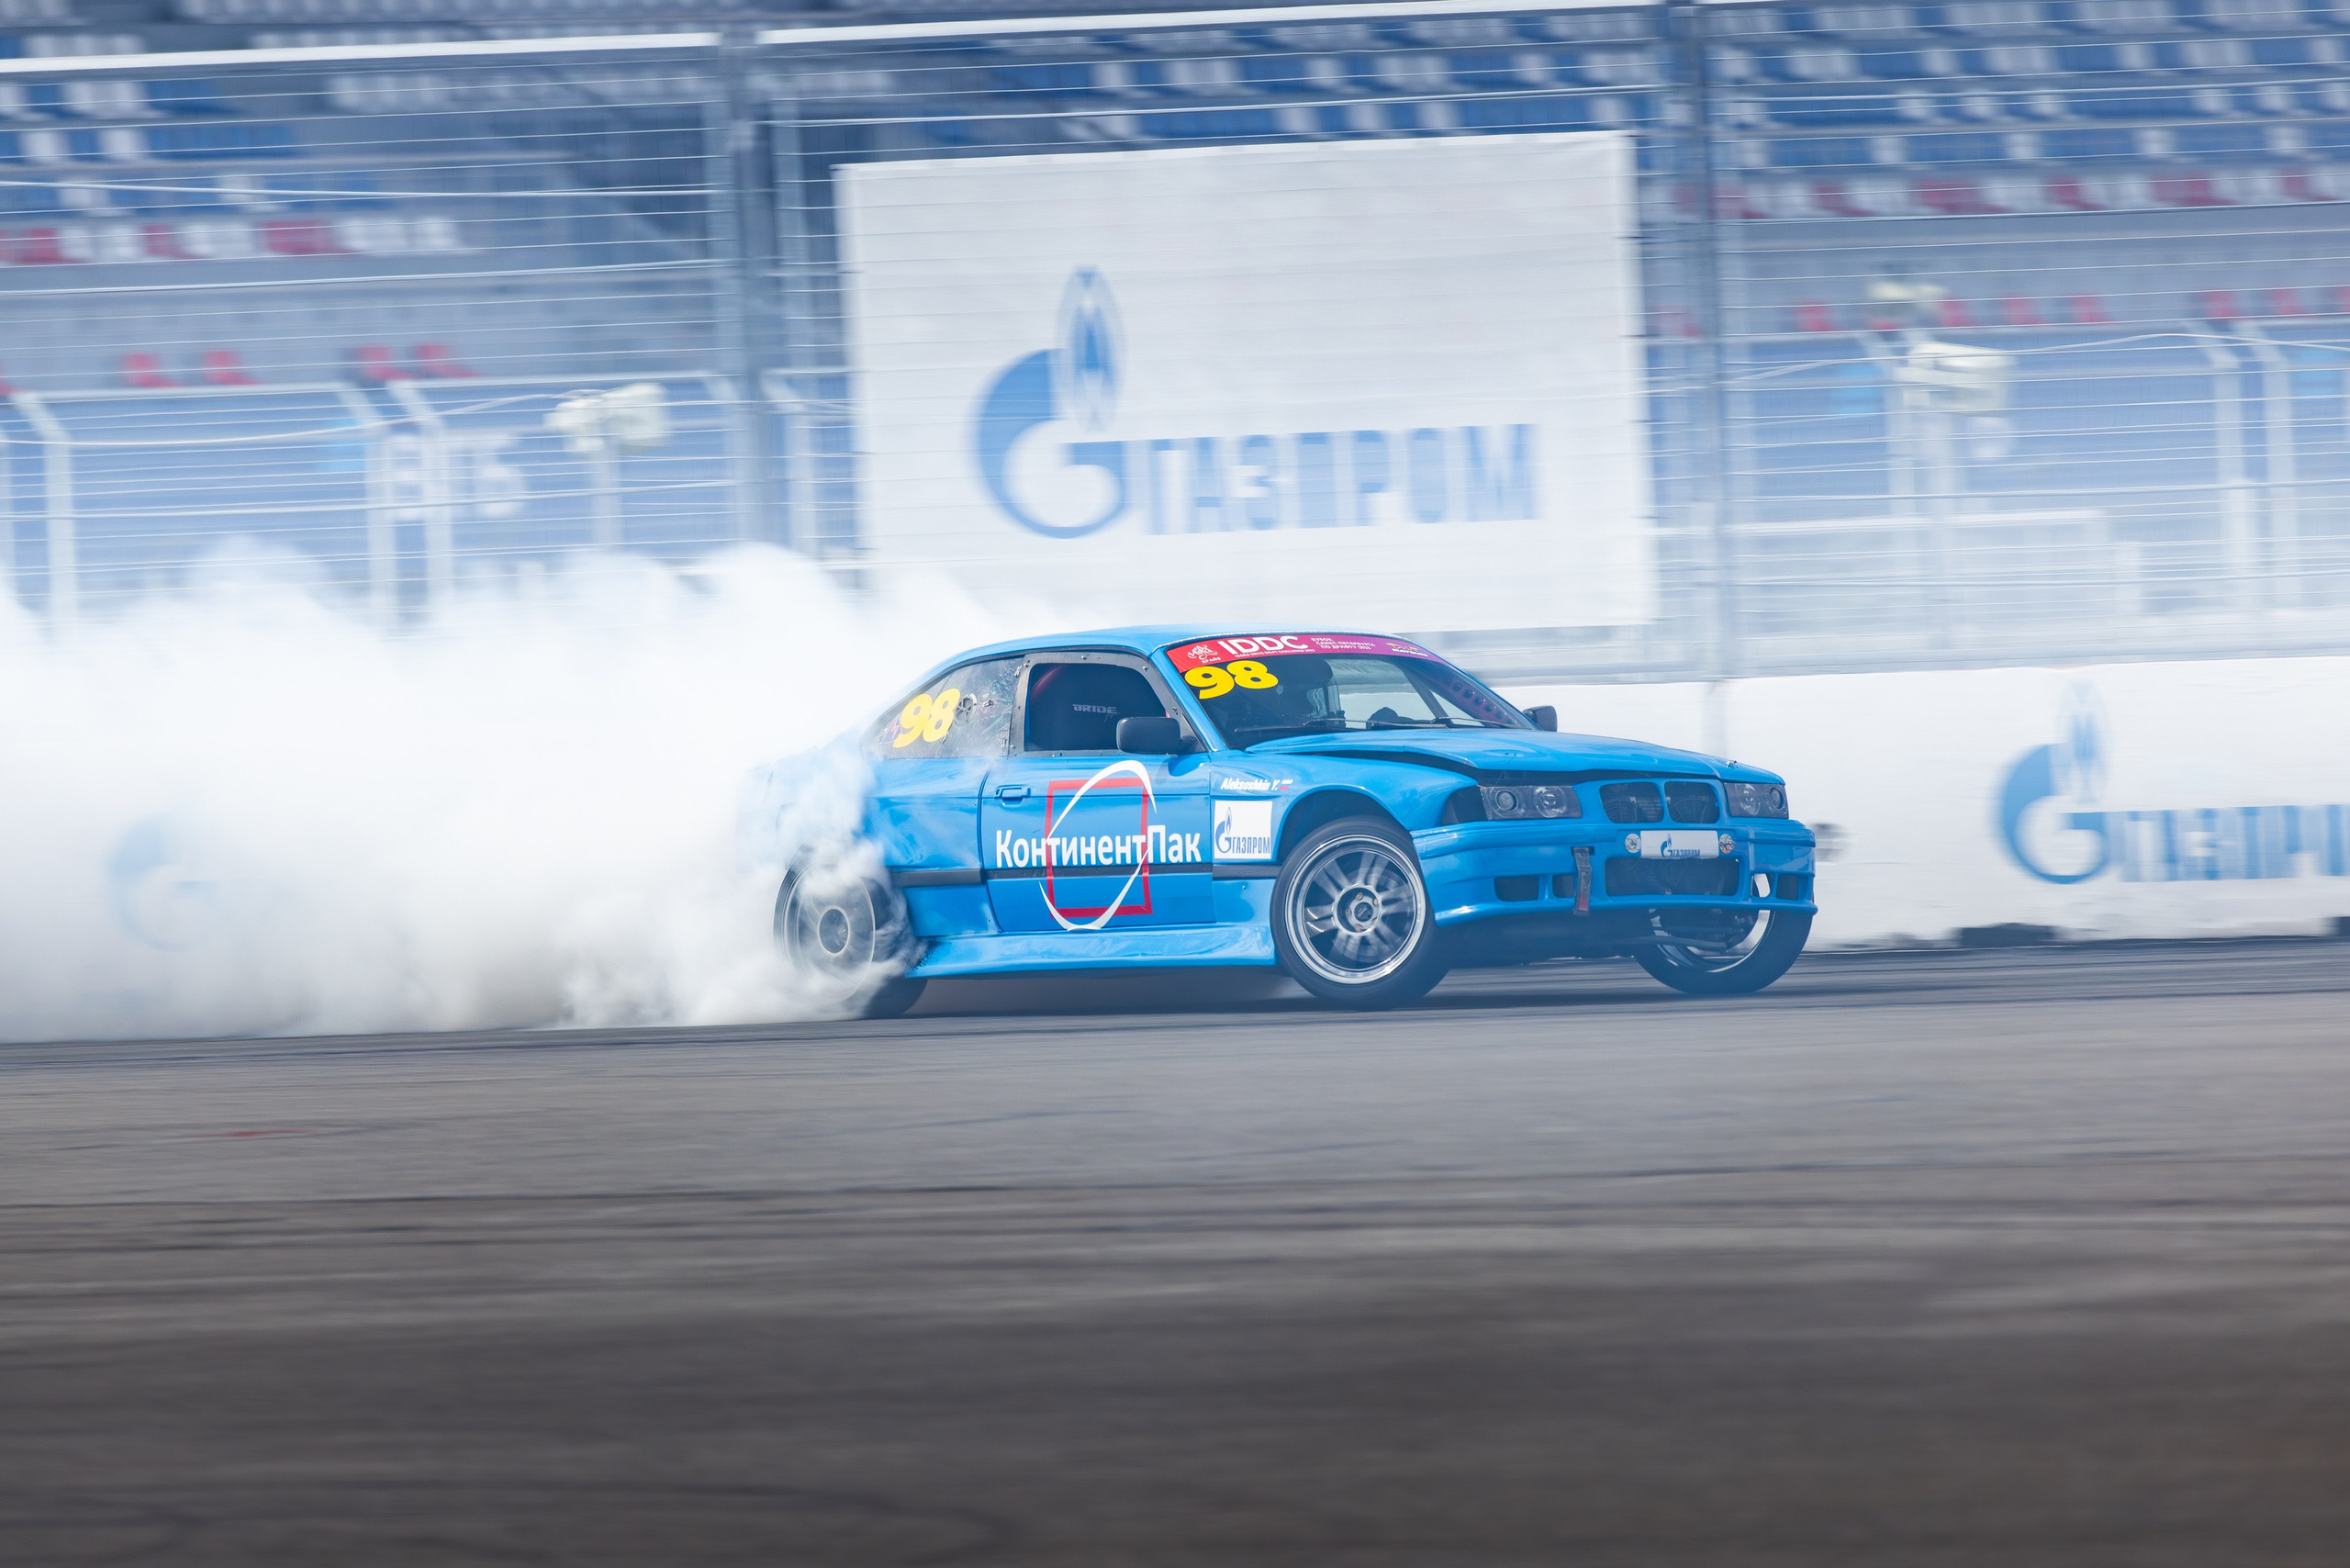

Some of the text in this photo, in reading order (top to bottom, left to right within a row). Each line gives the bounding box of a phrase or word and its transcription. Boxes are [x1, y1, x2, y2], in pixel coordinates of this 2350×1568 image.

[1144, 423, 1541, 536] ГАЗПРОМ
[1217, 635, 1309, 655] IDDC
[1184, 660, 1279, 700] 98
[892, 689, 960, 748] 98
[1072, 703, 1118, 714] BRIDE
[1271, 779, 1281, 790] Y.
[996, 824, 1202, 868] КонтинентПак
[1232, 836, 1270, 854] ГАЗПРОМ
[1673, 848, 1700, 857] ГАЗПРОМ
